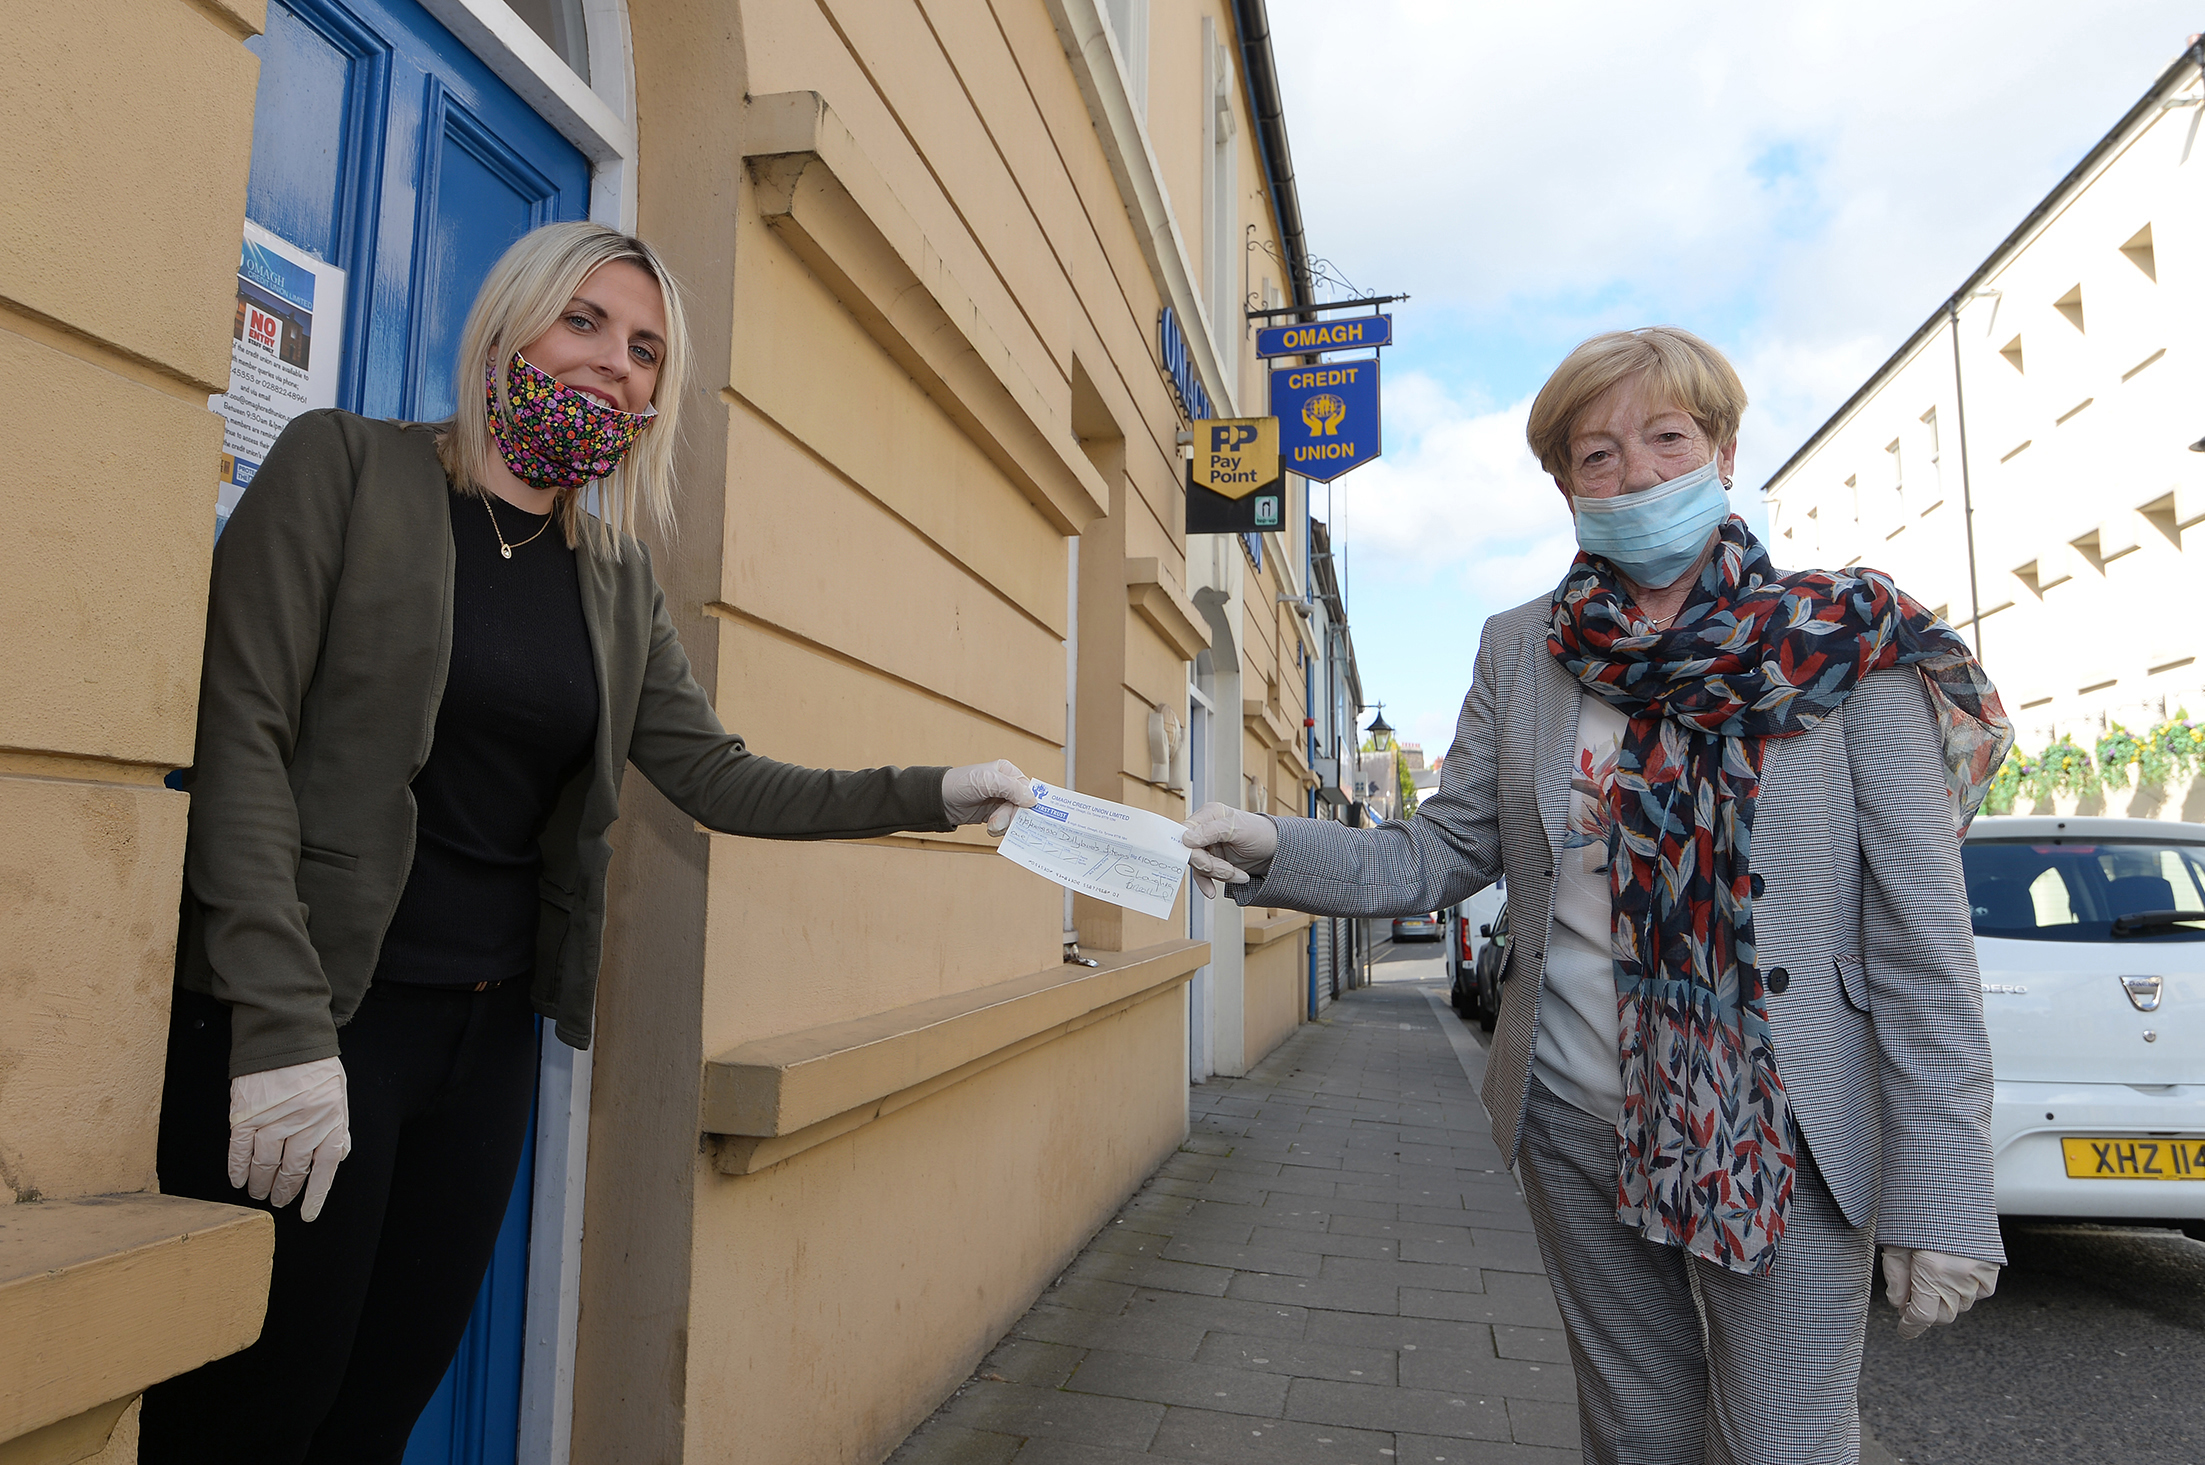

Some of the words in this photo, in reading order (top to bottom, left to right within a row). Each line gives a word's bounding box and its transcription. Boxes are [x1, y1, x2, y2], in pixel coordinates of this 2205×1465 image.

[247, 259, 285, 287] OMAGH
[248, 271, 269, 286] CREDIT
[270, 282, 289, 297] UNION
[289, 291, 313, 309] LIMITED
[250, 309, 276, 337] NO
[249, 328, 275, 348] ENTRY
[1283, 324, 1363, 348] OMAGH
[238, 358, 257, 371] member
[246, 349, 259, 359] credit
[260, 355, 272, 365] union
[282, 364, 302, 379] available
[1288, 368, 1359, 389] CREDIT
[240, 384, 250, 393] and
[258, 392, 272, 402] email
[223, 401, 246, 416] Between
[1294, 442, 1354, 461] UNION
[1210, 455, 1241, 471] Pay
[1210, 469, 1257, 483] Point
[1035, 804, 1050, 814] FIRST
[1051, 809, 1067, 818] TRUST
[1051, 795, 1072, 805] OMAGH
[1072, 800, 1092, 811] CREDIT
[1092, 806, 1109, 816] UNION
[1109, 811, 1130, 821] LIMITED
[1981, 984, 2028, 994] DERO
[2091, 1143, 2163, 1174] XHZ
